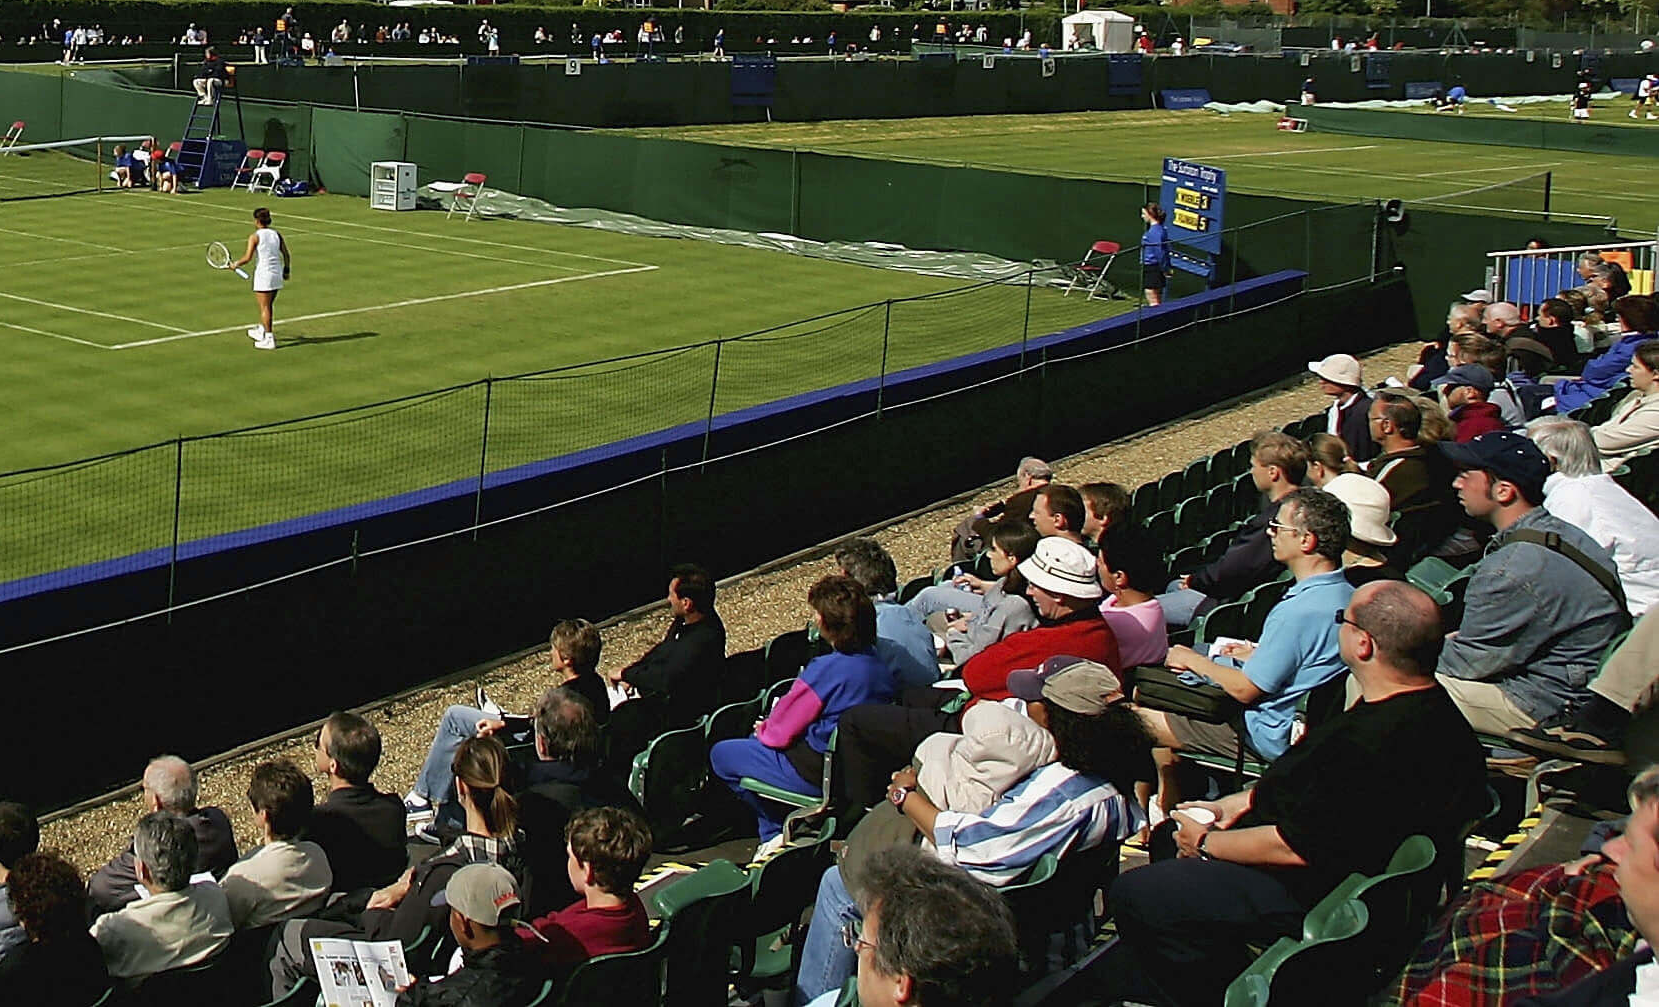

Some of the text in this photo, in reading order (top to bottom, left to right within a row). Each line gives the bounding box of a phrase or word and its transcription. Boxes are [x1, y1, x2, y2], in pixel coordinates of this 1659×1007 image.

[570, 60, 577, 74] 9
[1201, 195, 1208, 209] 3
[1199, 217, 1206, 231] 5
